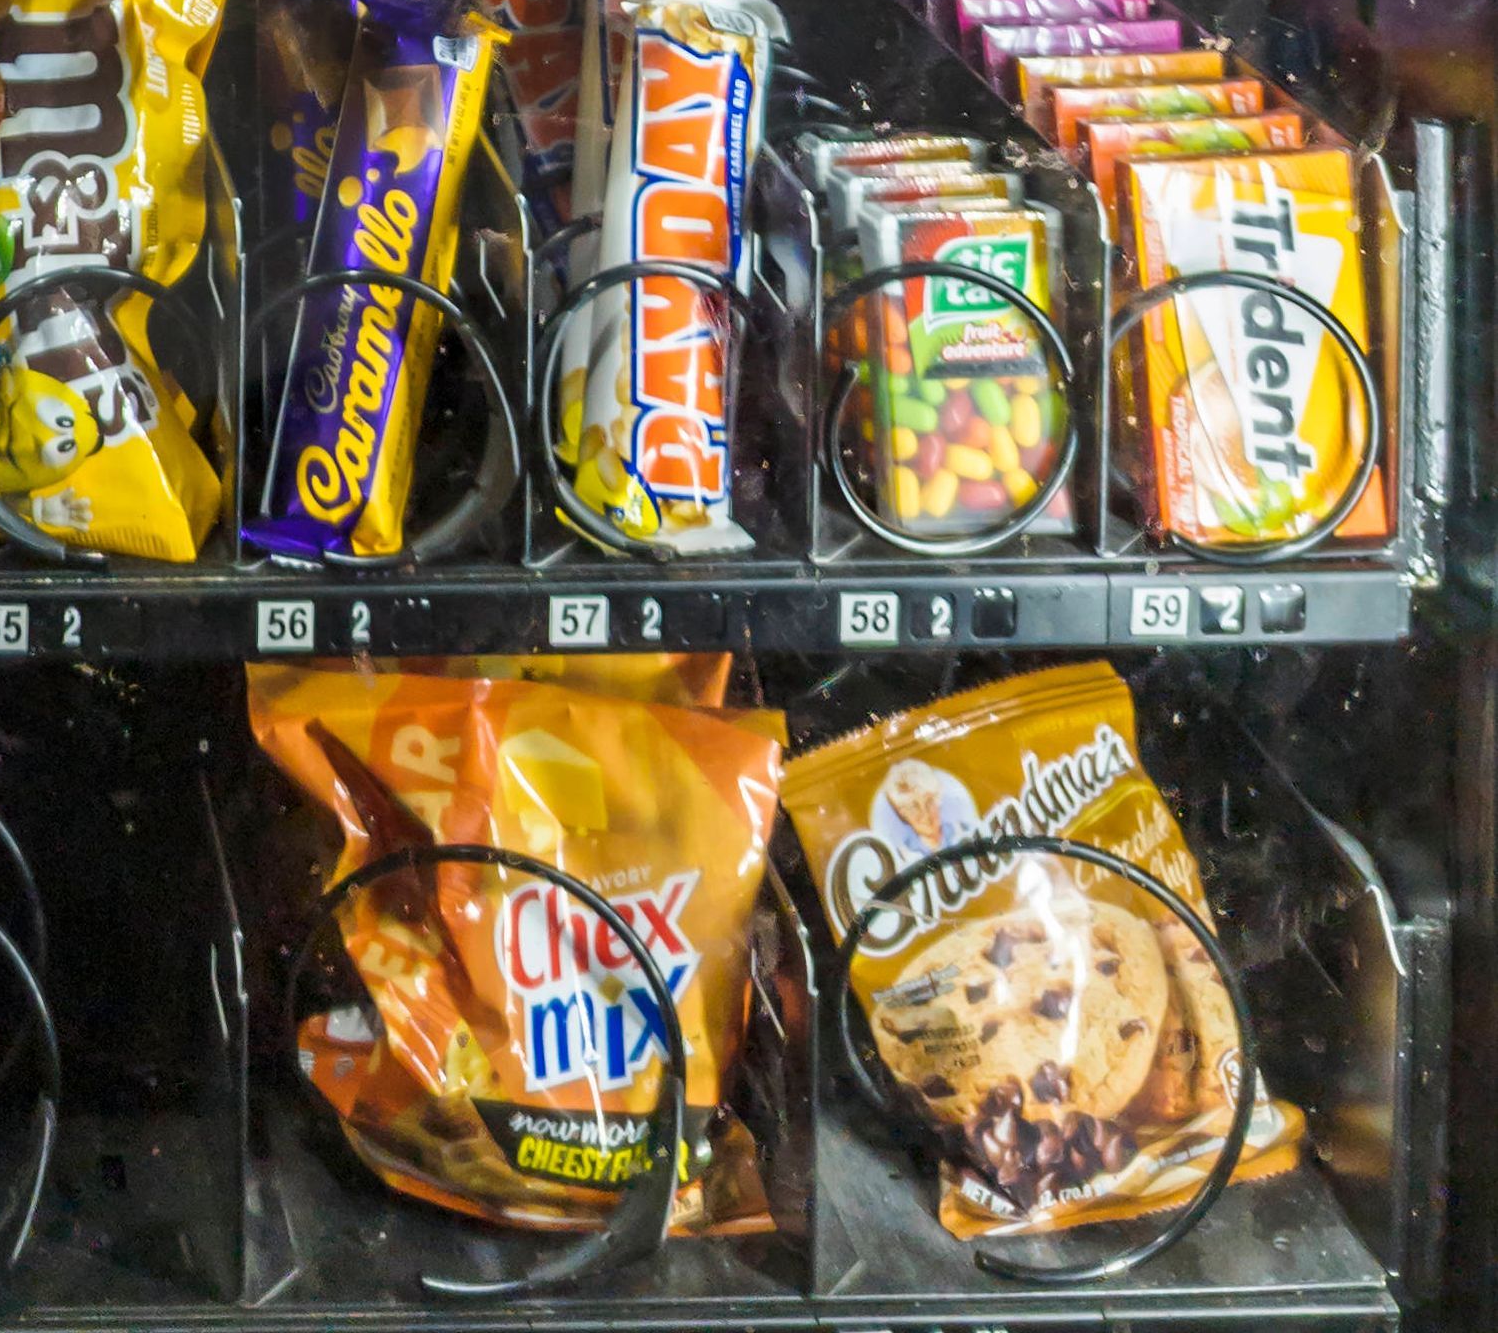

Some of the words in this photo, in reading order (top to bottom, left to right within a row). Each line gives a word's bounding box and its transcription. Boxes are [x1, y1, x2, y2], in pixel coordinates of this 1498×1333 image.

[734, 77, 748, 102] BAR
[729, 105, 745, 182] CARAMEL
[638, 33, 731, 500] PAYDAY
[959, 245, 1015, 279] tic
[962, 320, 1003, 340] fruit
[1232, 198, 1313, 481] Trdent
[297, 188, 420, 524] Caramello
[942, 338, 1026, 360] adventure
[266, 605, 309, 642] 56
[560, 604, 601, 640] 57
[849, 598, 891, 633] 58
[1141, 593, 1182, 629] 59
[501, 881, 687, 992] Chex
